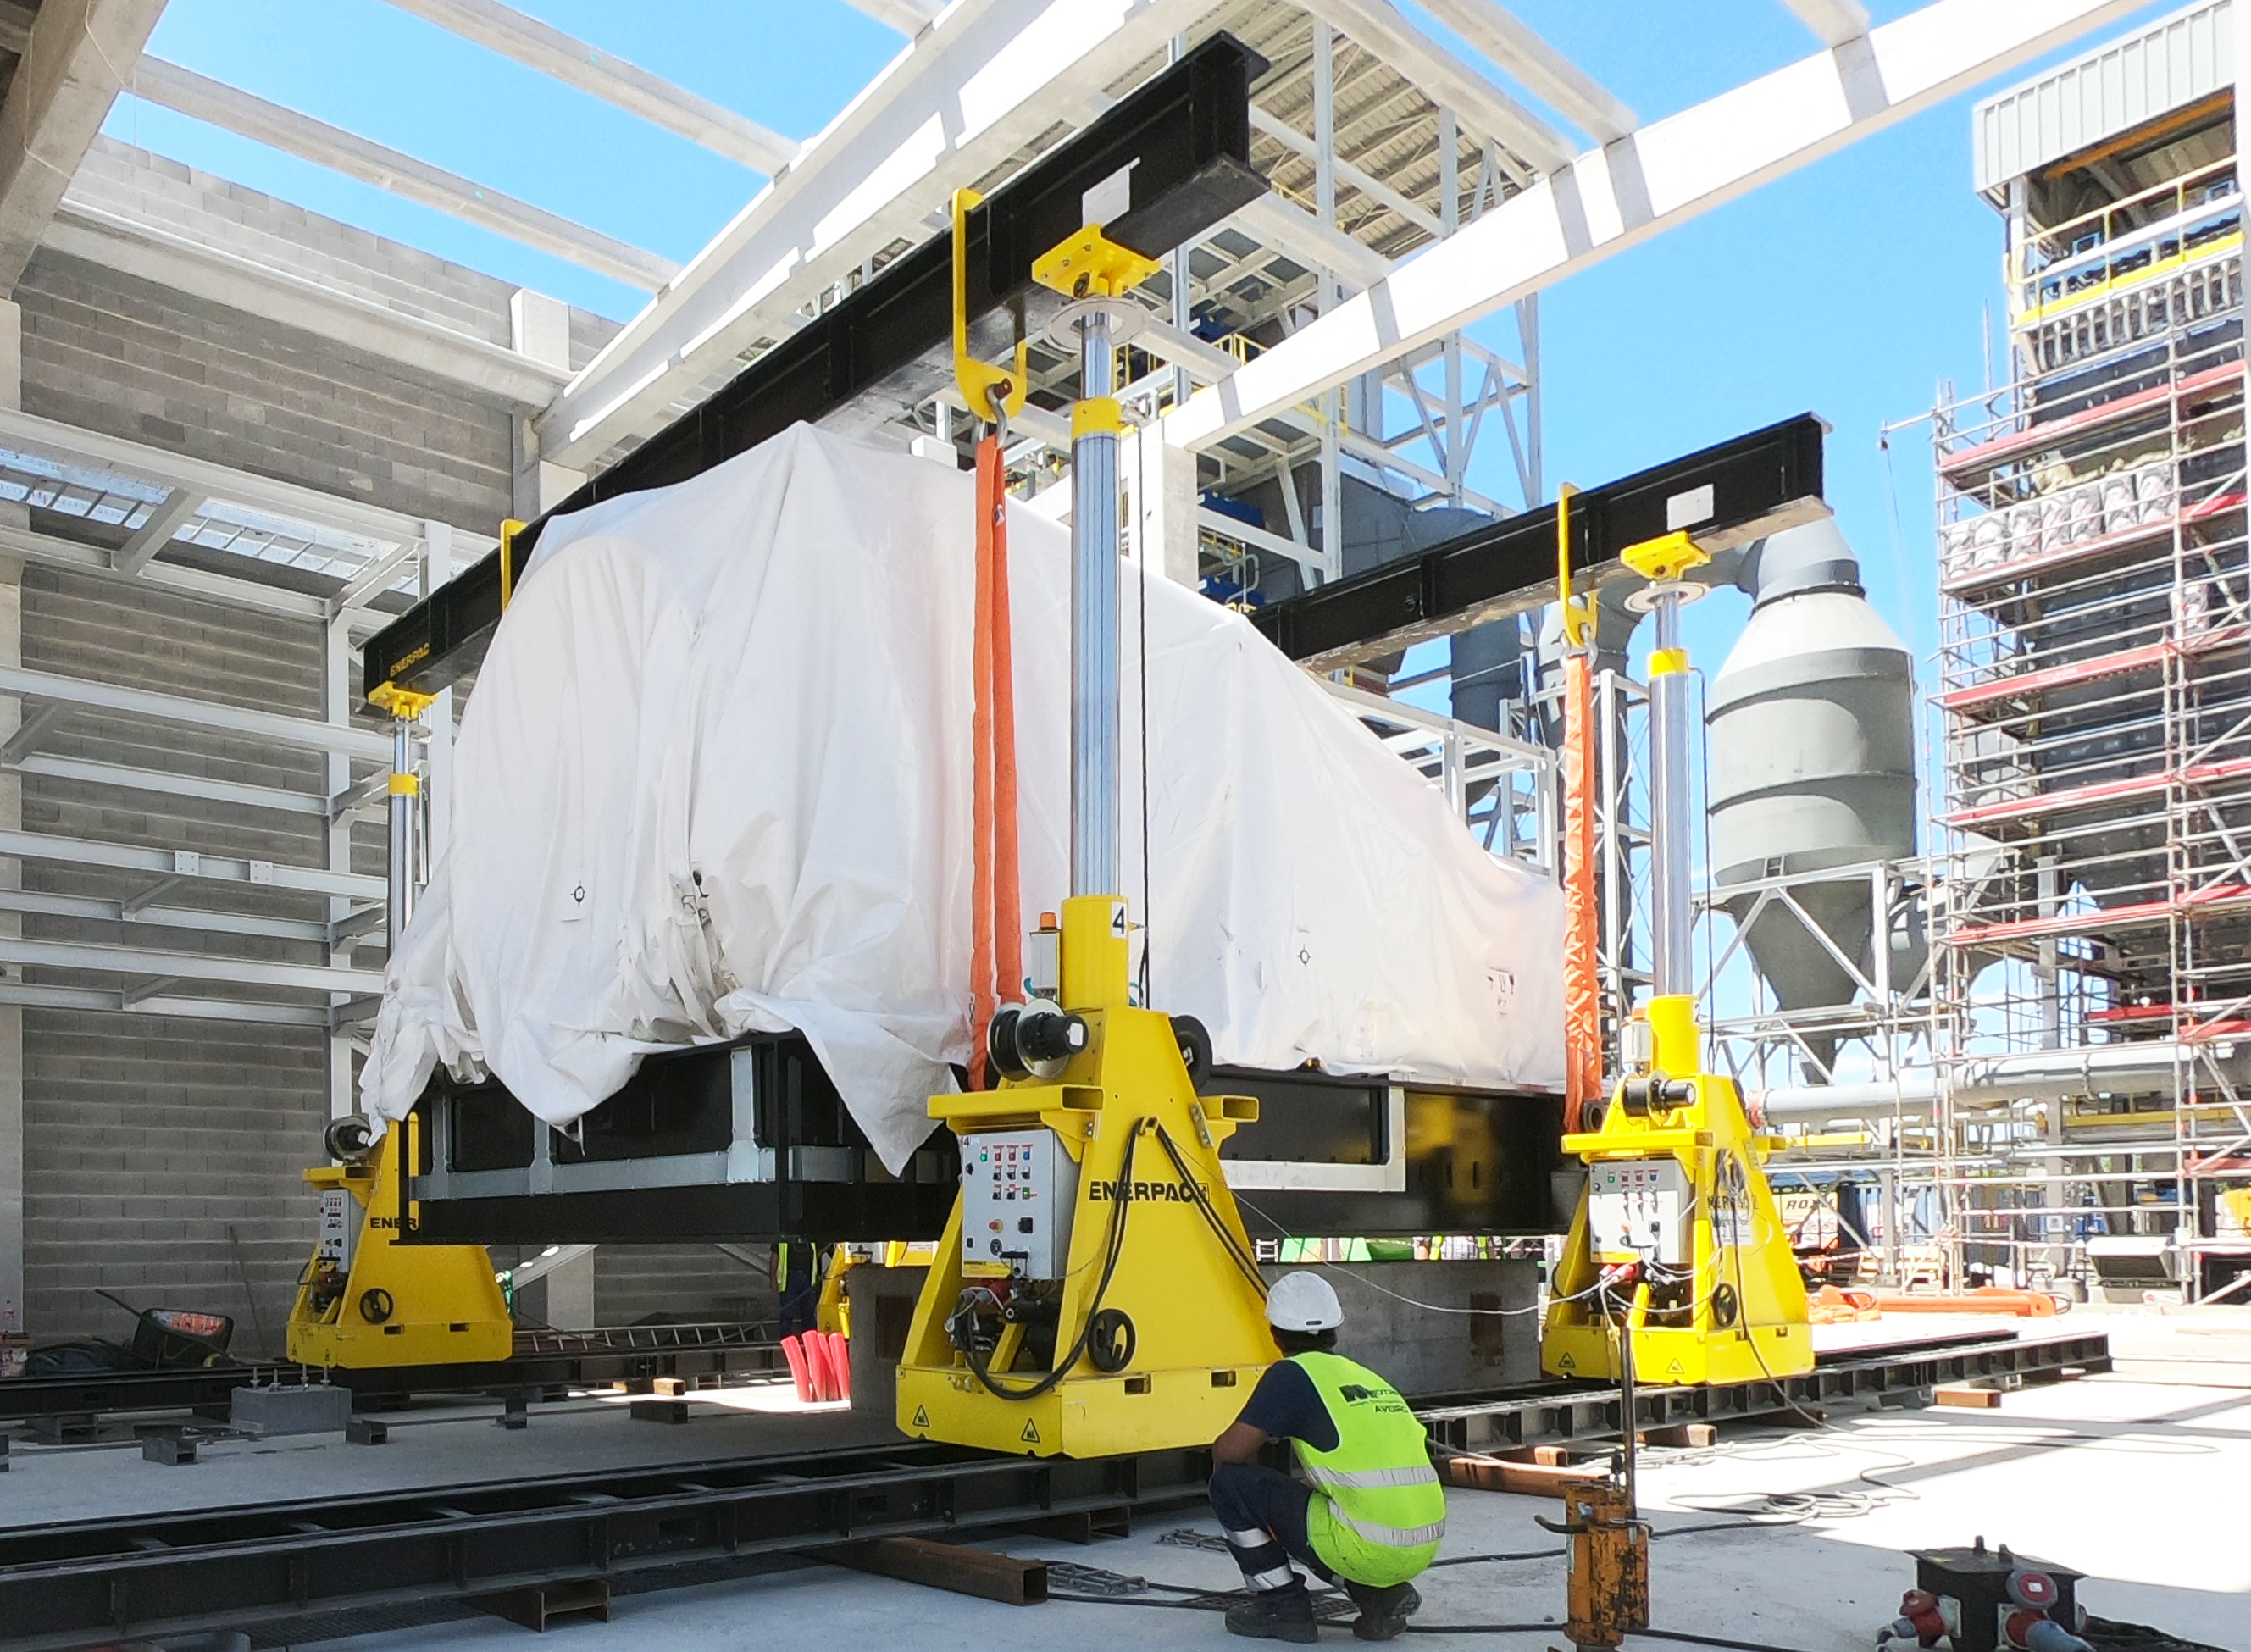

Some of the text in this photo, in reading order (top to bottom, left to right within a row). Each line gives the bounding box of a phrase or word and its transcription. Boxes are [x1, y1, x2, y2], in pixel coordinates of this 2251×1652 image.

[390, 641, 430, 678] ENERPAC
[1112, 906, 1125, 934] 4
[963, 1136, 970, 1147] 4
